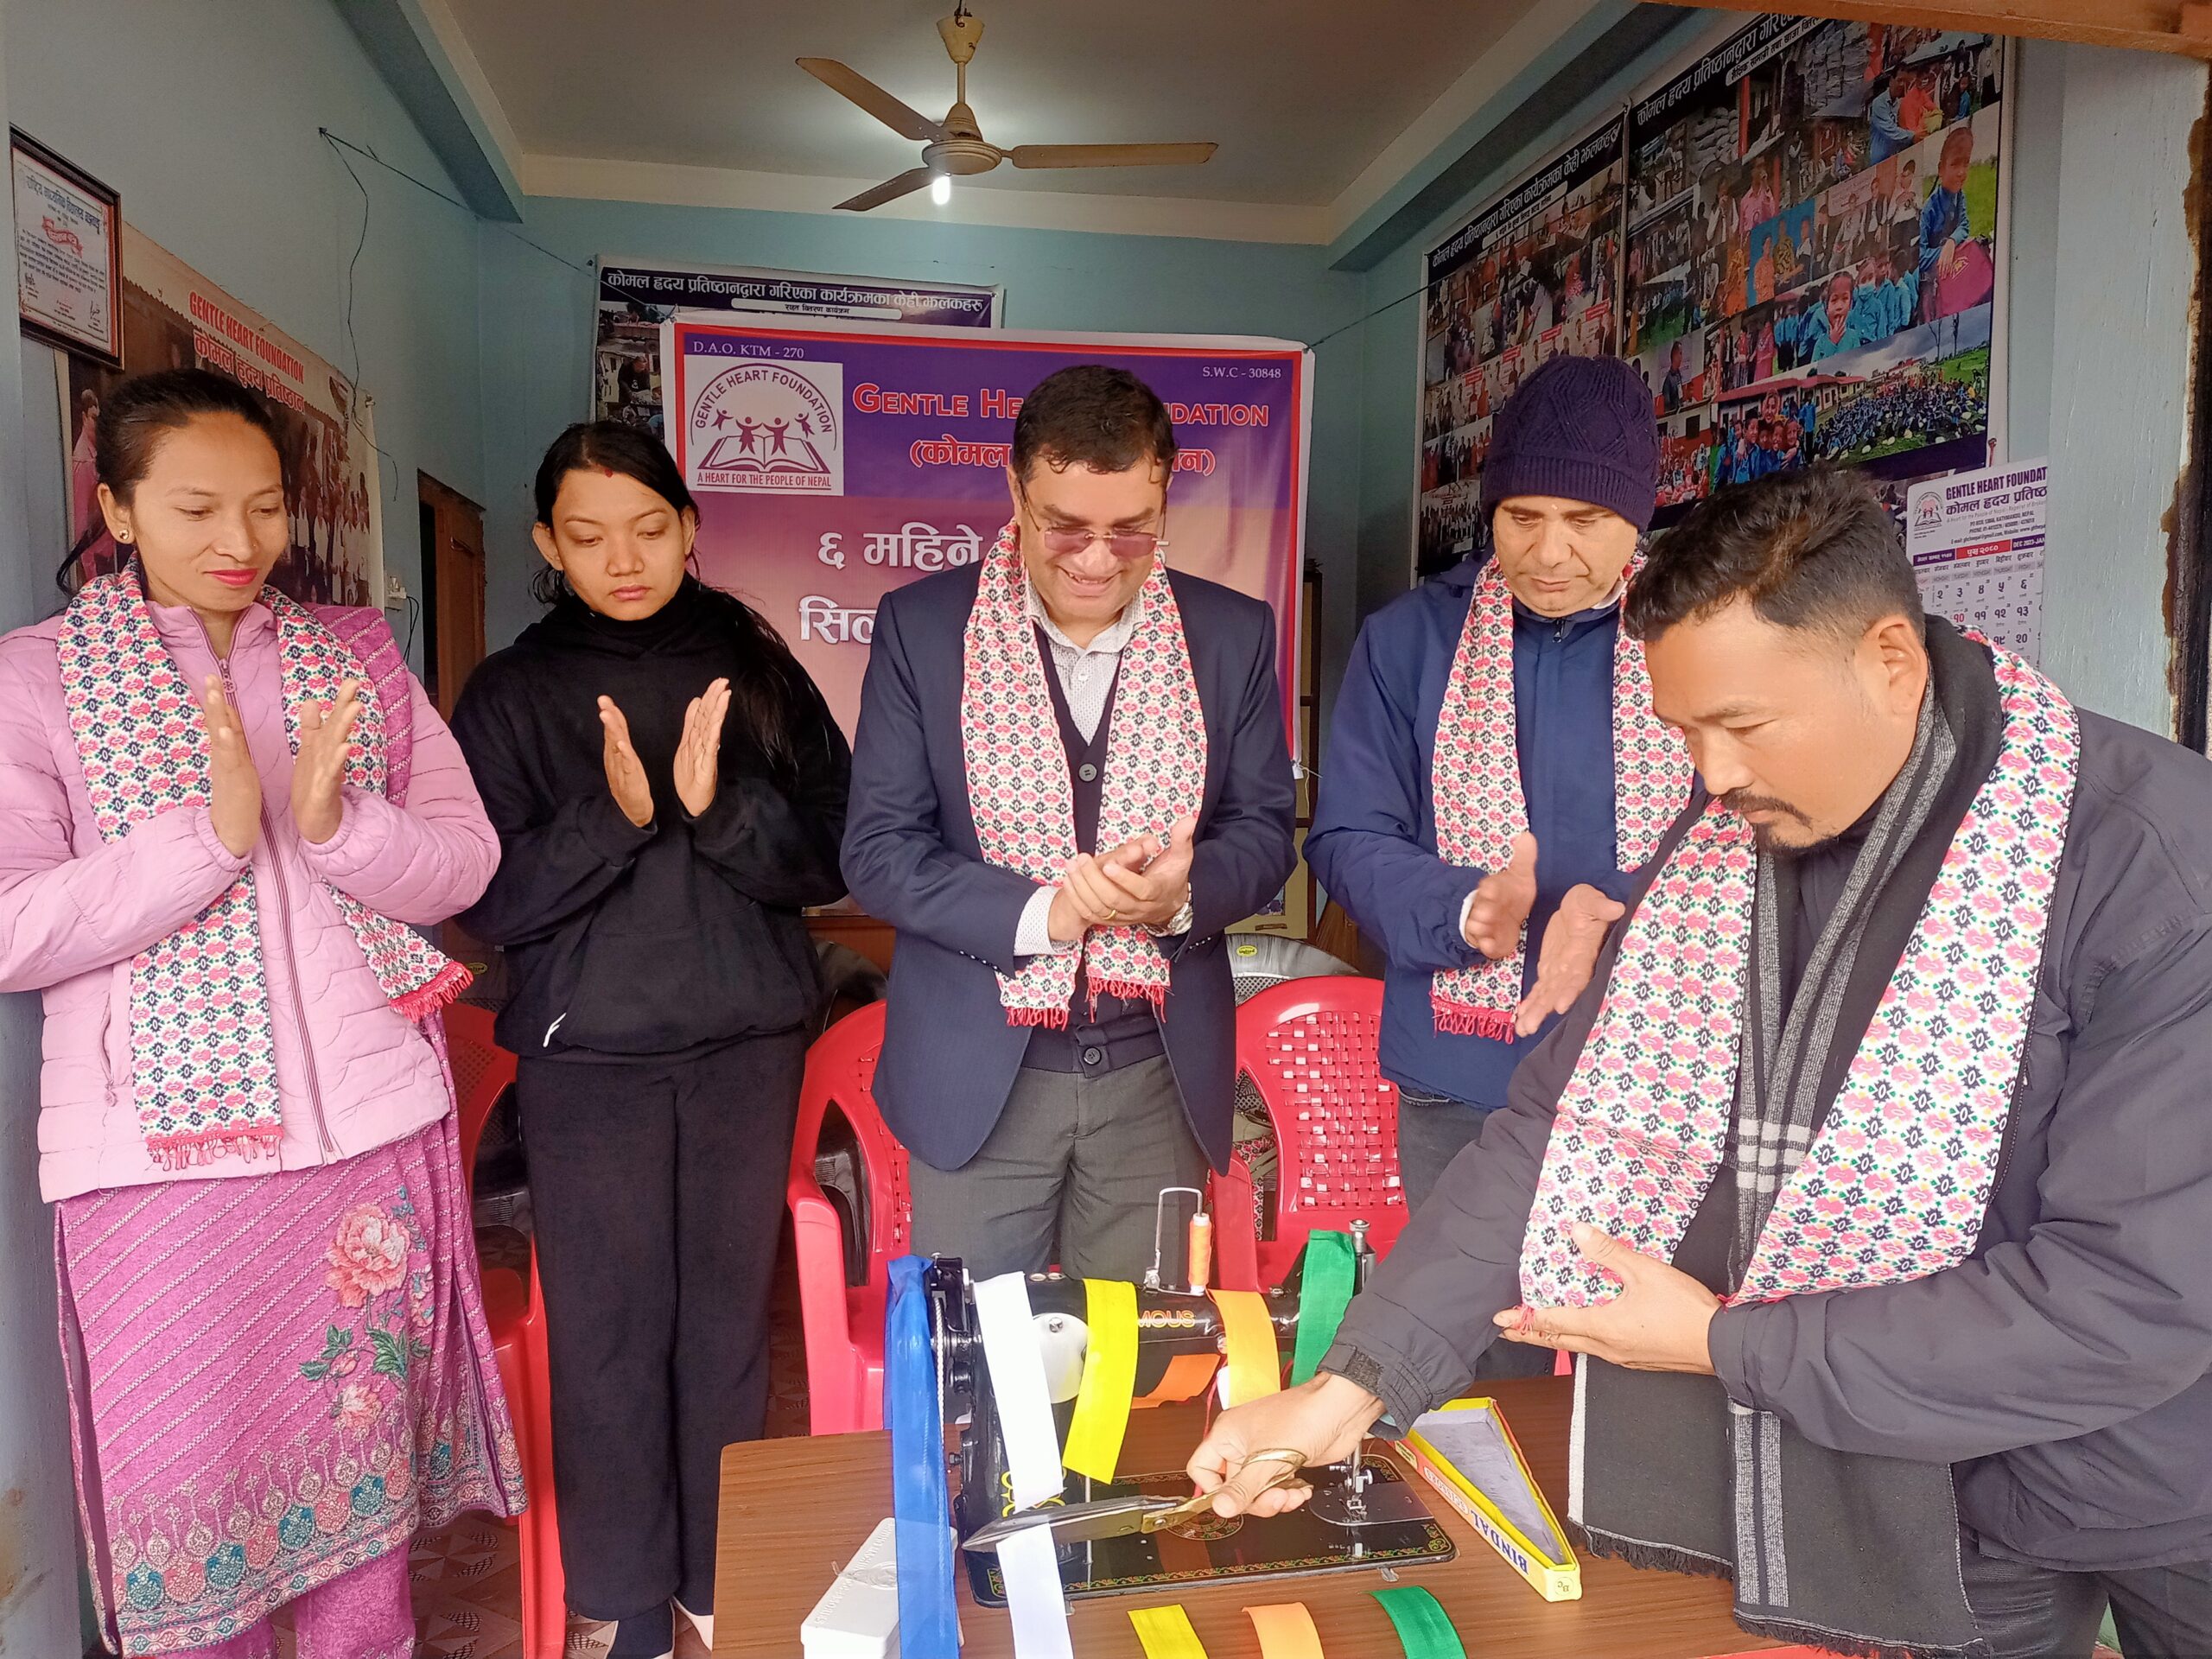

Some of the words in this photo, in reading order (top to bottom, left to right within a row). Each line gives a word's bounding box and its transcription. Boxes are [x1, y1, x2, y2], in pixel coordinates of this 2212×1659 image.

[1637, 91, 1666, 126] कोमल
[1668, 74, 1693, 105] हृदय
[1564, 149, 1580, 175] केही
[607, 270, 649, 289] कोमल
[649, 276, 684, 291] हृदय
[689, 276, 766, 298] प्रतिष्ठानद्वारा
[769, 282, 816, 300] गरिएका
[821, 287, 891, 305] कार्यक्रमका
[891, 289, 919, 307] केही
[189, 290, 225, 334] GENTLE
[226, 315, 254, 353] HEART
[256, 334, 304, 385] FOUNDATION
[693, 341, 735, 354] D.A.O.
[741, 345, 771, 357] KTM
[784, 347, 804, 359] 270
[194, 328, 235, 375] कोमल
[236, 355, 264, 391] हृदय
[264, 372, 306, 415] प्रतिष्ठान
[1203, 366, 1238, 378] S.W.C
[1249, 368, 1281, 378] 30848
[696, 383, 727, 429] GENTLE
[726, 370, 769, 388] HEART
[772, 372, 832, 433] FOUNDATION
[1163, 403, 1268, 427] DATION
[910, 433, 1012, 467] (कोमल
[697, 472, 703, 482] A
[705, 473, 729, 484] HEART
[732, 474, 747, 484] FOR
[749, 474, 763, 485] THE
[766, 474, 793, 486] PEOPLE
[796, 476, 806, 486] OF
[808, 476, 831, 487] NEPAL
[1946, 482, 1975, 500] GENTLE
[1977, 475, 2005, 494] HEART
[2006, 466, 2048, 487] FOUNDAT
[1946, 499, 1980, 515] कोमल
[1983, 493, 2010, 509] हृदय
[2014, 486, 2048, 504] प्रतिष्ठ
[817, 532, 846, 570] ६
[863, 522, 983, 572] महिने
[1980, 545, 1999, 554] २०८०
[1936, 590, 1943, 599] २
[1956, 588, 1963, 597] ३
[1978, 584, 1984, 594] ४
[1998, 582, 2005, 592] ५
[2020, 579, 2027, 589] ६
[1954, 613, 1964, 623] १०
[1974, 611, 1986, 620] ११
[1994, 608, 2006, 619] १२
[2017, 606, 2029, 616] १३
[2016, 633, 2028, 643] २०
[1138, 1309, 1196, 1329] MOUS
[1471, 1510, 1529, 1575] BINDAL
